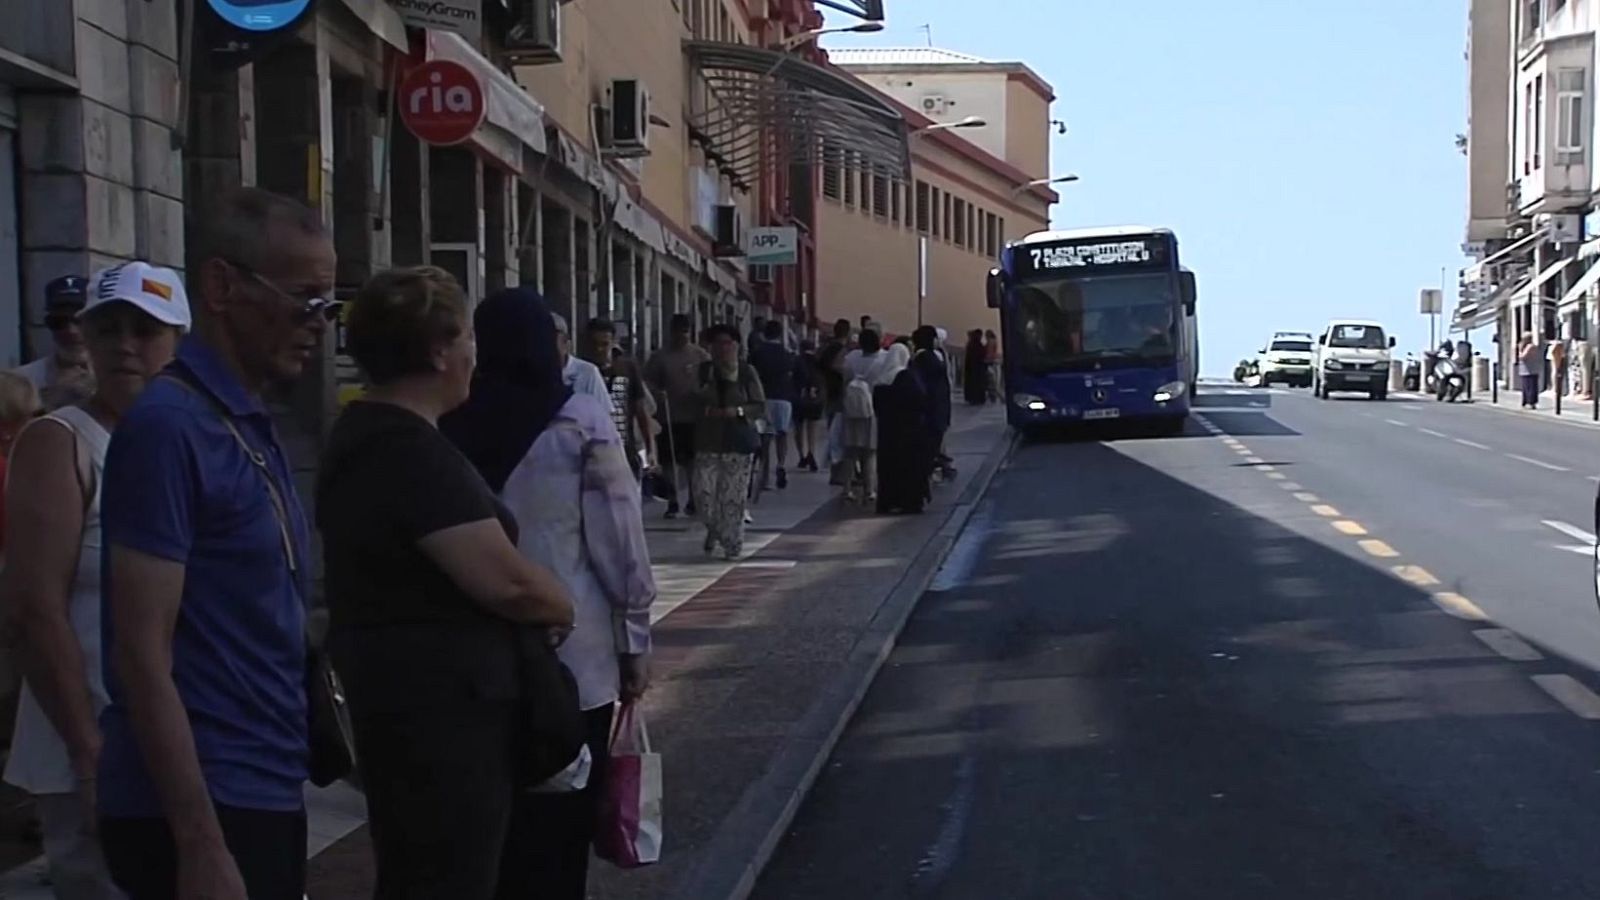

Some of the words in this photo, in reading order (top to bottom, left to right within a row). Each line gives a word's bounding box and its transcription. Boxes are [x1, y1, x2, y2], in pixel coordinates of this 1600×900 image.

[399, 0, 478, 20] oneyGram
[410, 71, 473, 114] ria
[1030, 249, 1041, 270] 7
